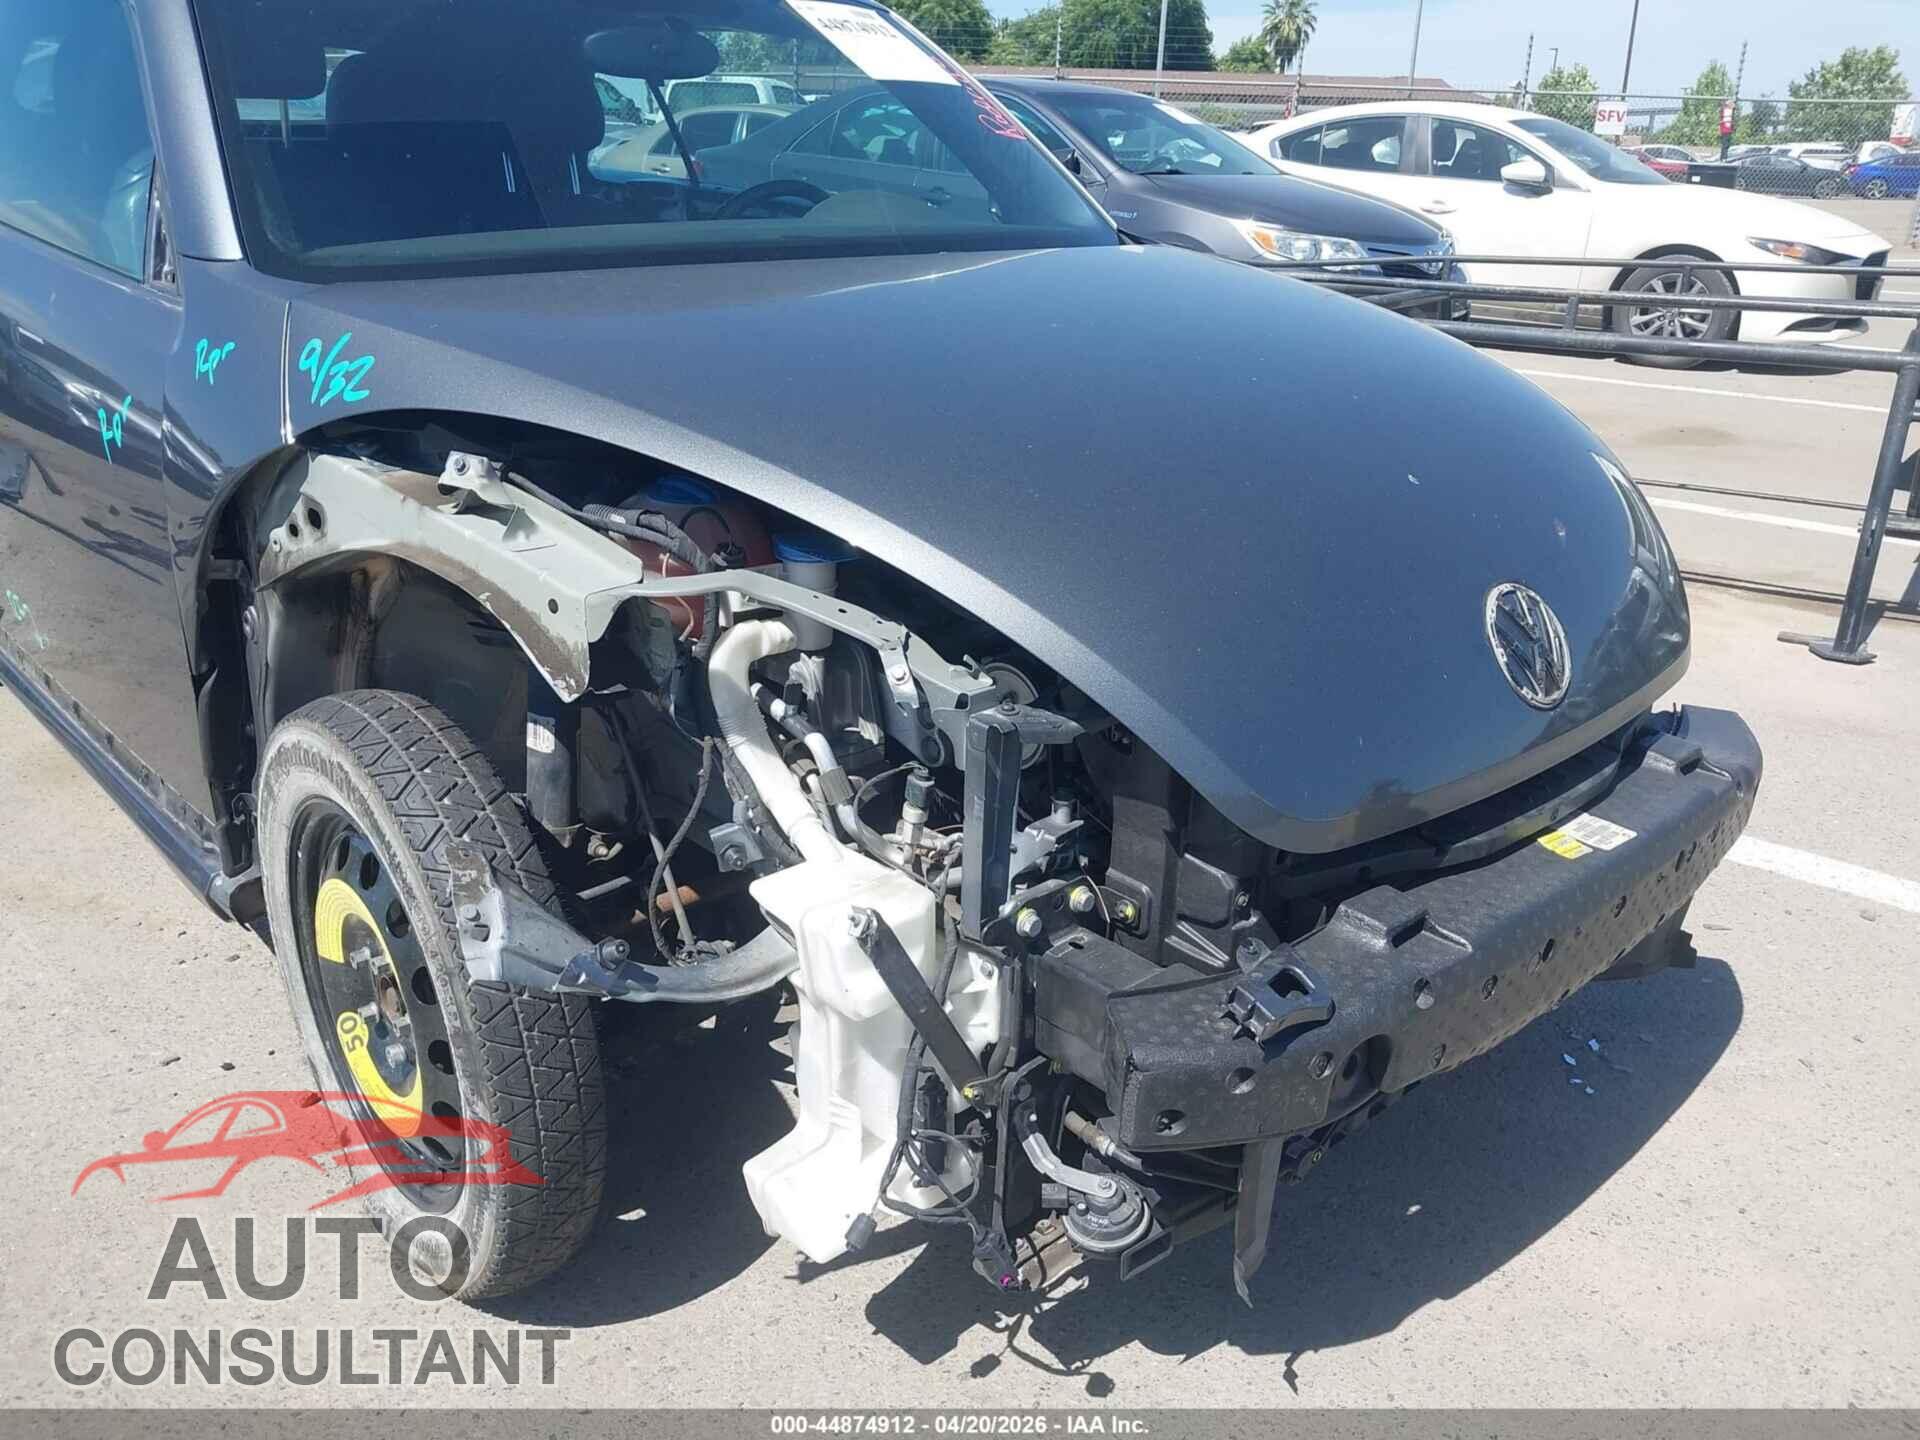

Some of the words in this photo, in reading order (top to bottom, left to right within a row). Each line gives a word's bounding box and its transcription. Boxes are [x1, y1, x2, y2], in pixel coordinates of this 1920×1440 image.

[1598, 109, 1626, 122] SFV
[298, 331, 376, 407] 9/32
[340, 1015, 364, 1053] 50
